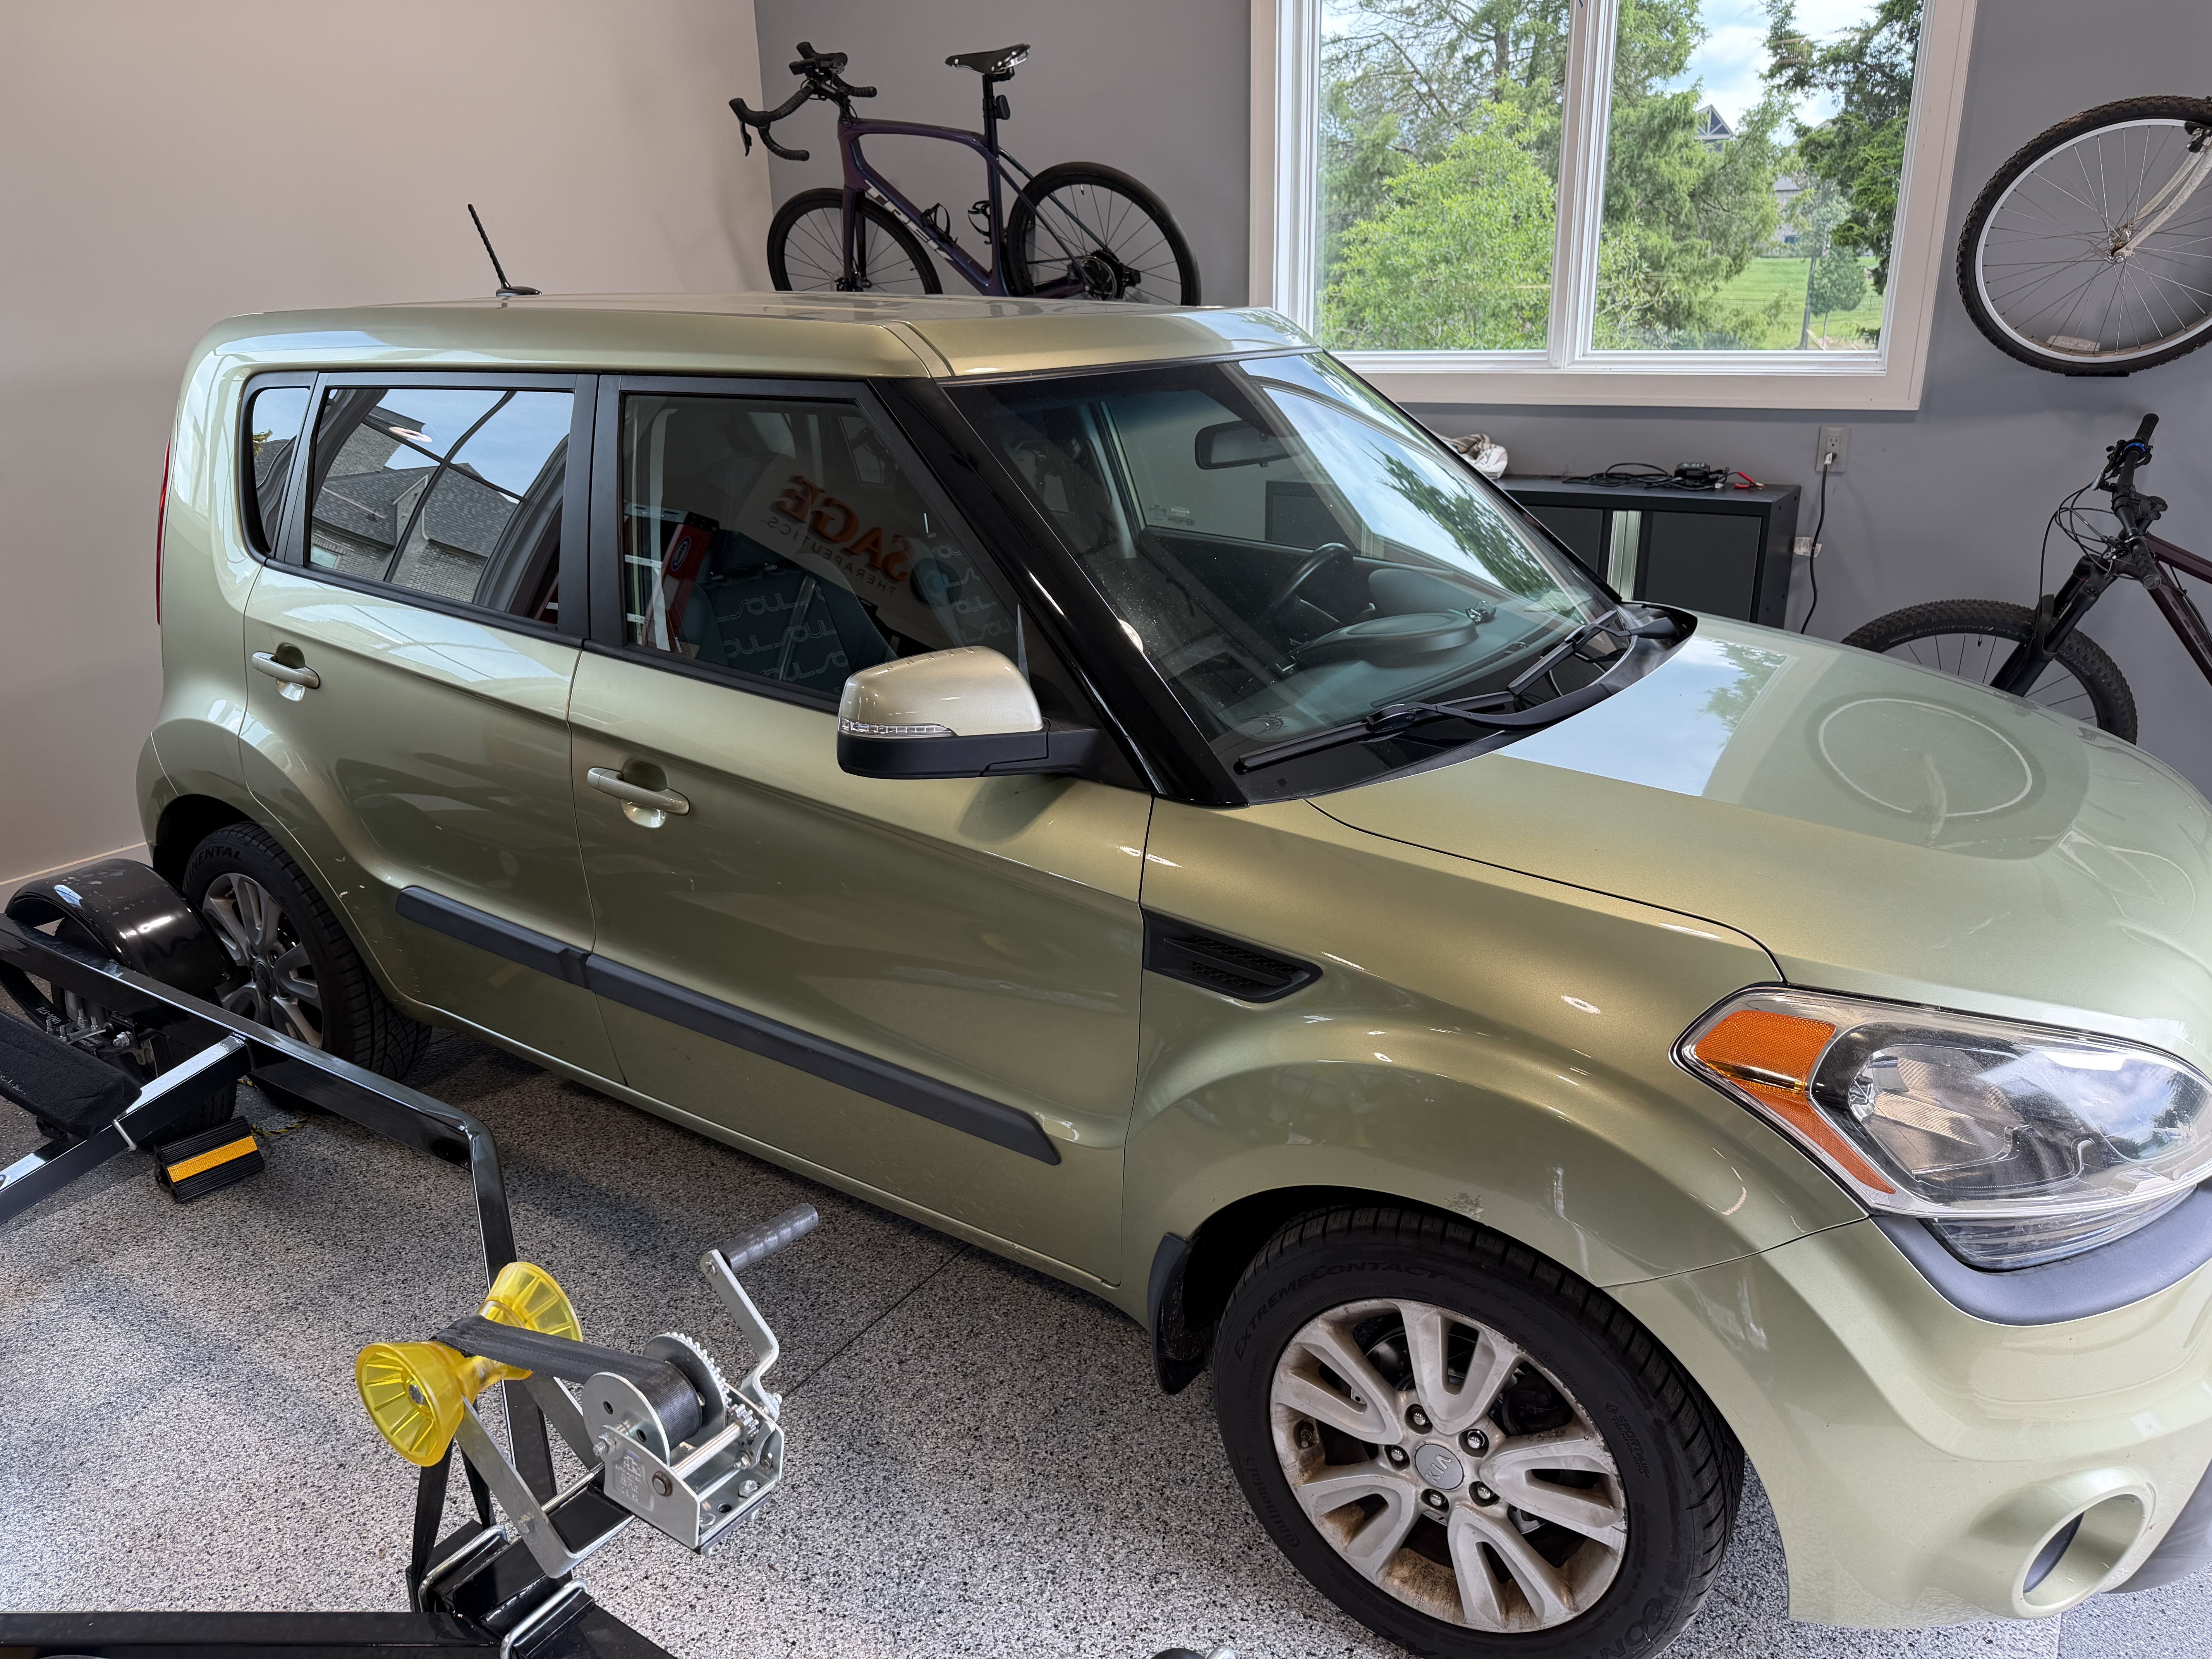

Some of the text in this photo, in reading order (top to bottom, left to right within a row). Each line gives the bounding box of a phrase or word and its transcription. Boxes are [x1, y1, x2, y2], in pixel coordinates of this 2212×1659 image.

[864, 179, 954, 261] TREK
[36, 1006, 62, 1024] UNA-178
[1425, 1454, 1452, 1484] KIA
[1611, 1417, 1644, 1474] TECHNOLOGY
[1246, 1467, 1301, 1548] Continental
